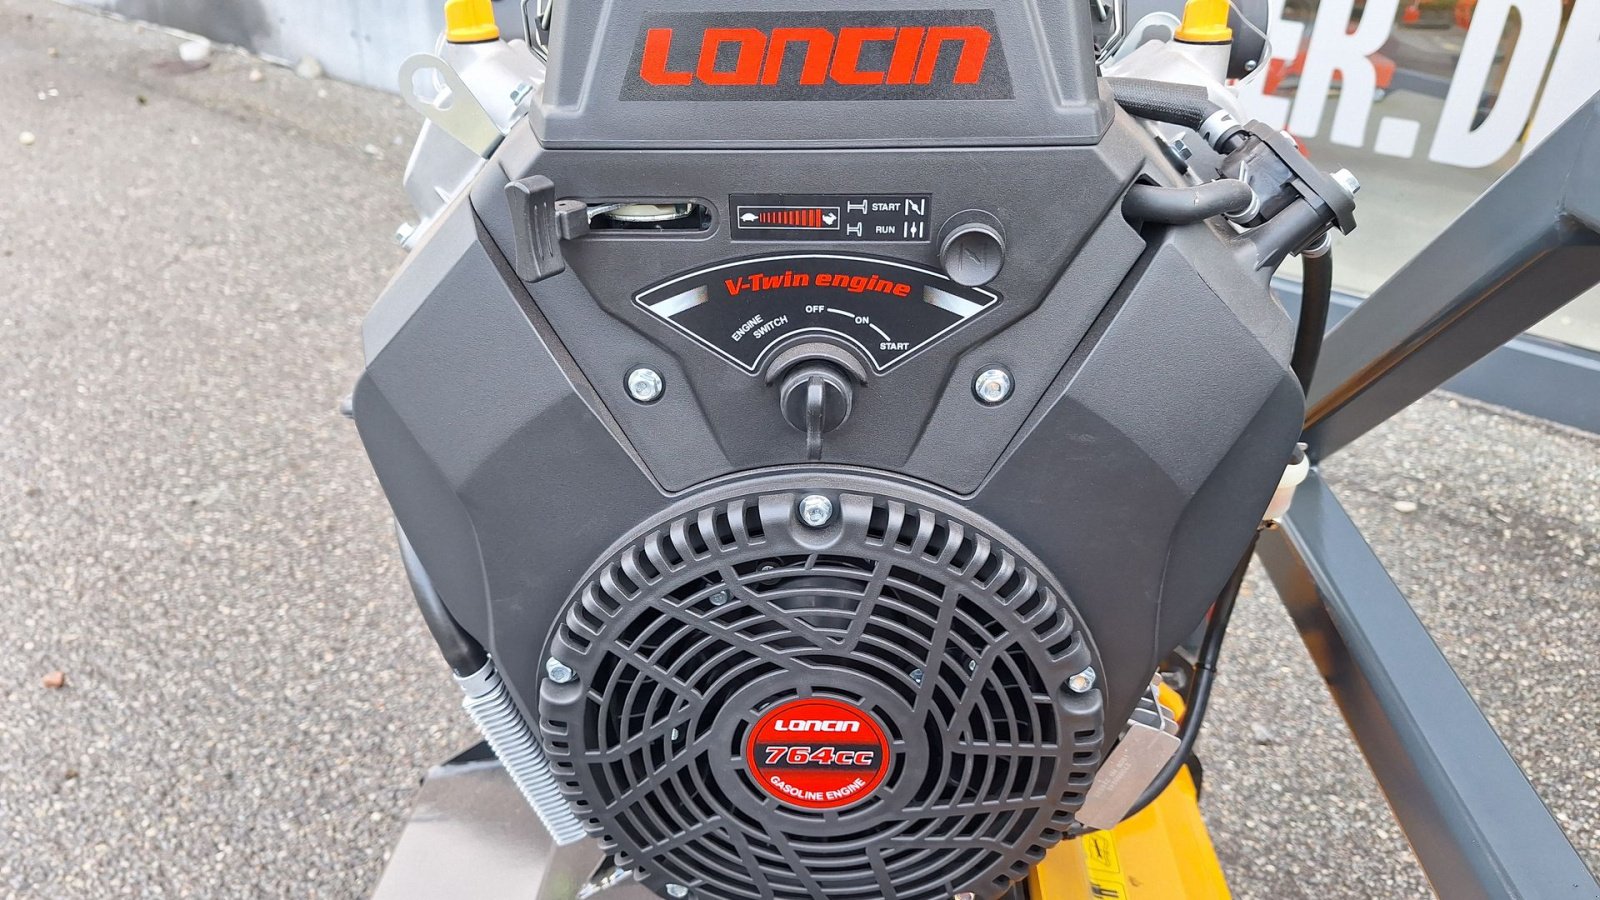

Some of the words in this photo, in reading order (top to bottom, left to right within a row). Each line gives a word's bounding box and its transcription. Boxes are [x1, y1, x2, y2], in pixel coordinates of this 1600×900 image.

[640, 26, 991, 85] LONCIN
[872, 203, 901, 211] START
[875, 226, 896, 234] RUN
[725, 270, 810, 296] V-Twin
[815, 272, 912, 297] engine
[805, 305, 825, 313] OFF
[731, 314, 764, 342] ENGINE
[752, 314, 789, 339] SWITCH
[855, 316, 870, 324] ON
[880, 342, 910, 350] START
[774, 719, 861, 732] LONCIN
[765, 746, 874, 765] 764cc
[770, 775, 824, 801] GASOLINE
[826, 777, 866, 800] ENGINE
